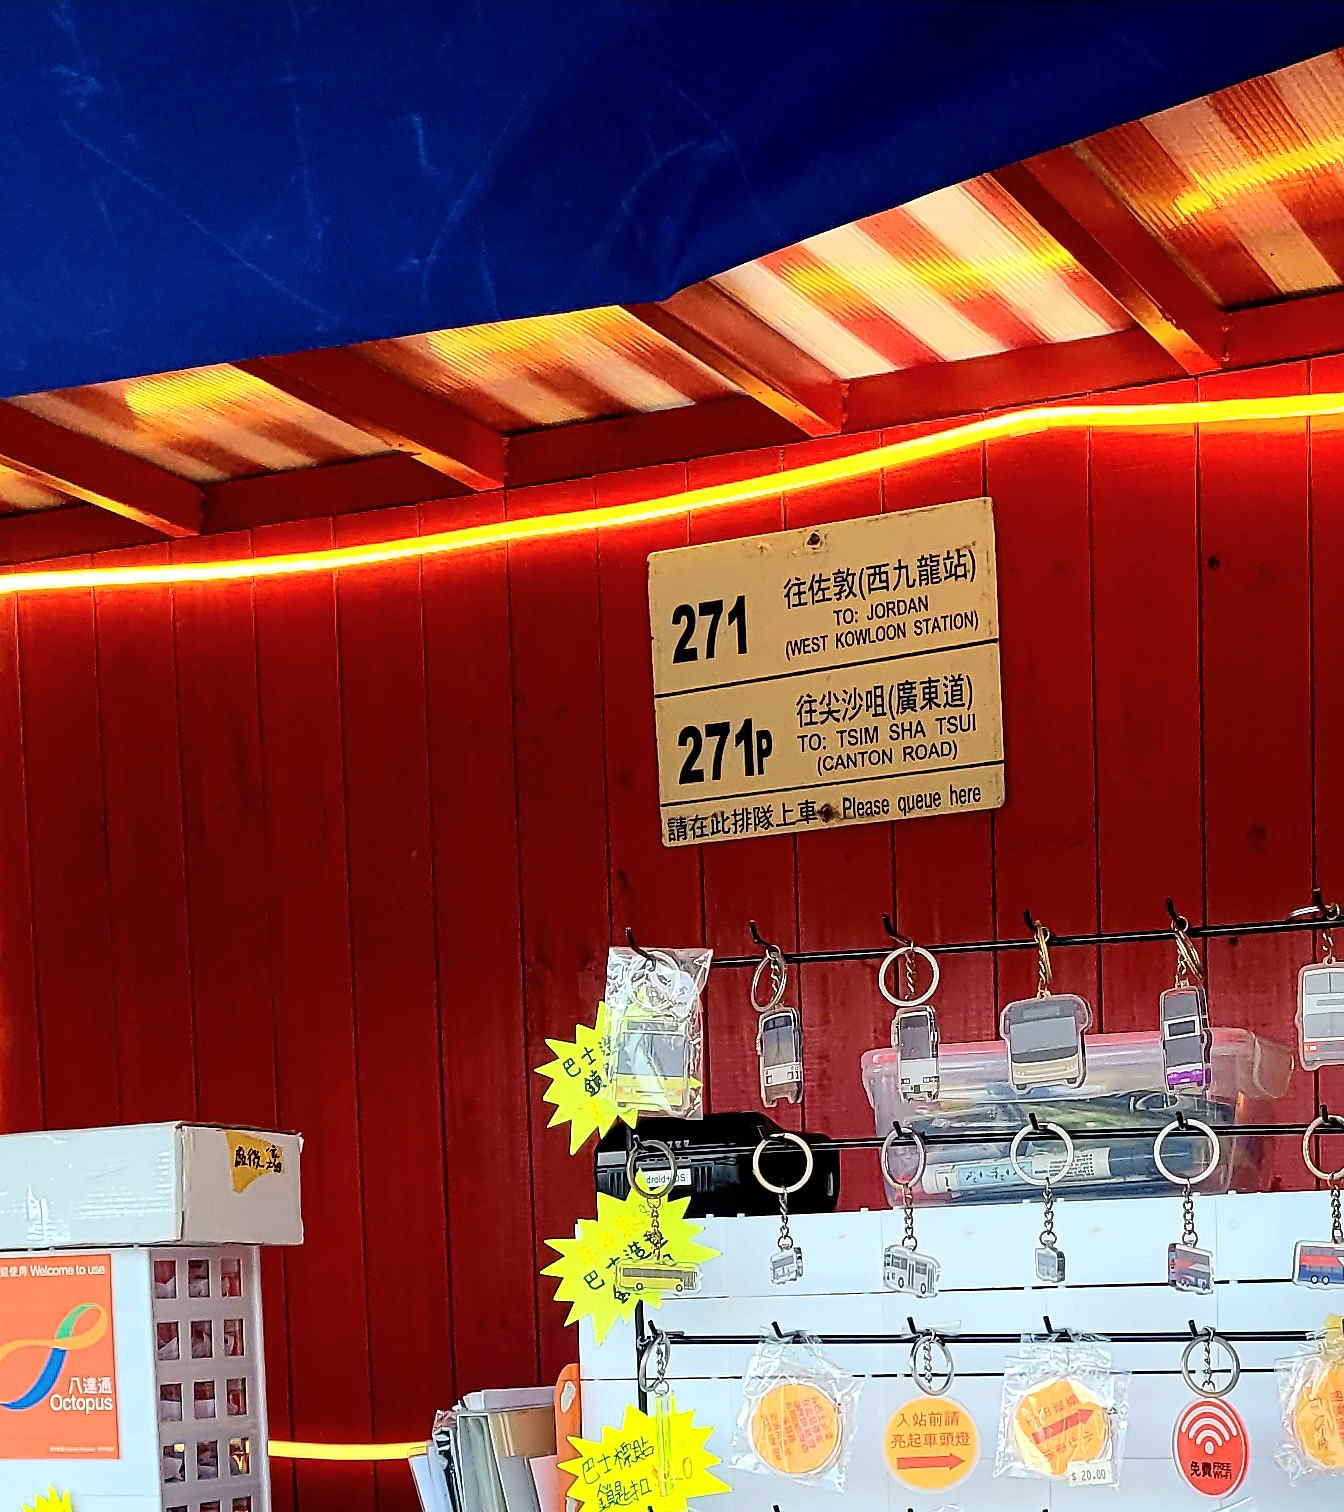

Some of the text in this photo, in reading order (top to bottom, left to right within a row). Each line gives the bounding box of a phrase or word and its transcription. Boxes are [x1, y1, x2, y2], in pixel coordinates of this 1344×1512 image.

[784, 549, 976, 609] 往佐敦(西九龍站)
[833, 596, 929, 624] TO: JORDAN
[672, 595, 748, 664] 271
[785, 611, 979, 660] (WEST KOWLOON STATION)
[796, 674, 973, 727] 往尖沙咀(廣東道)
[797, 714, 976, 752] TO: TSIM SHA TSUI
[817, 742, 958, 776] (CANTON ROAD)
[668, 784, 981, 843] 請在此排隊上車 Please queue here
[30, 1265, 105, 1277] Welcome to use
[50, 1394, 113, 1414] Octopus
[68, 1377, 112, 1394] 八達通
